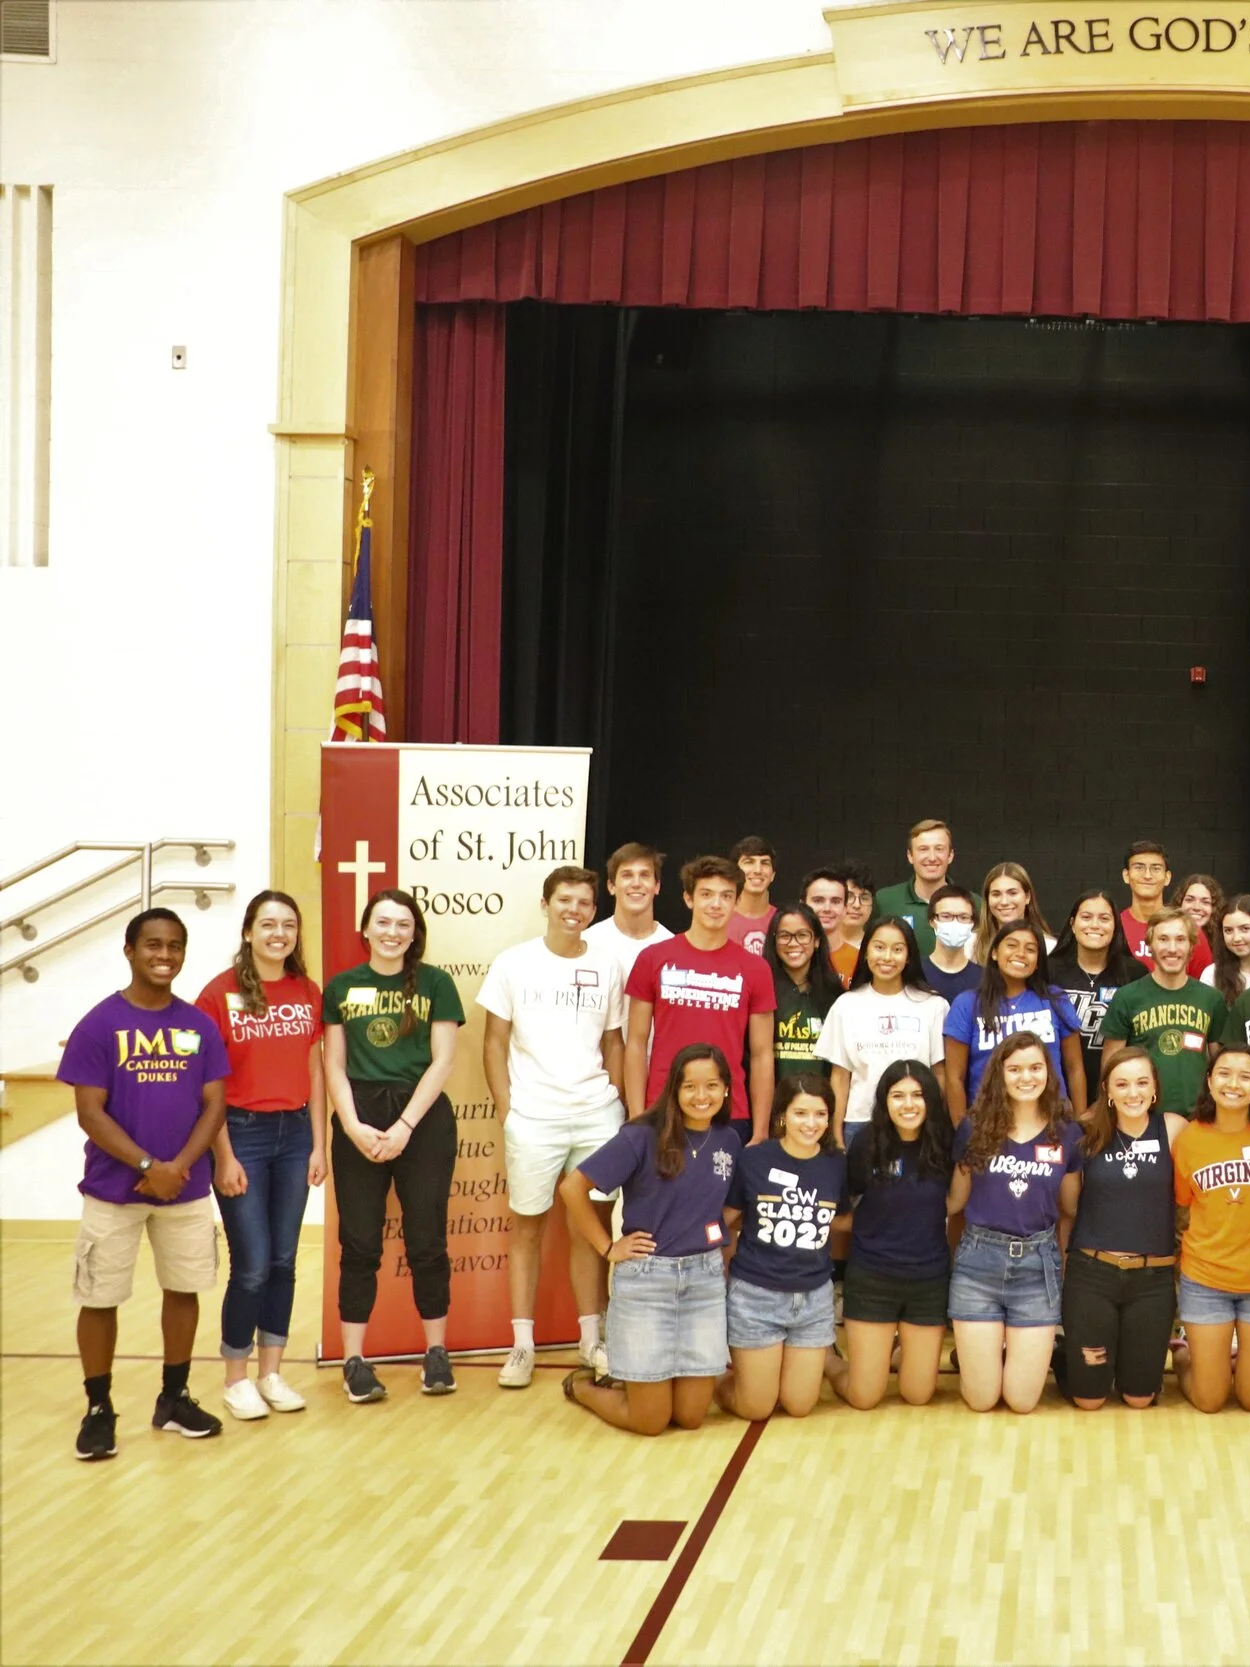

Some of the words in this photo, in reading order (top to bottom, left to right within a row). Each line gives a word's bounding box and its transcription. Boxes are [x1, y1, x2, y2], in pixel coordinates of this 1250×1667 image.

[924, 24, 1006, 65] WE
[1020, 18, 1114, 57] ARE
[410, 775, 574, 808] Associates
[409, 829, 444, 861] of
[457, 830, 494, 861] St.
[502, 829, 578, 870] John
[410, 885, 504, 915] Bosco
[669, 998, 729, 1012] COLLEGE
[232, 1021, 313, 1042] UNIVERSIT
[1132, 1004, 1211, 1036] FRANCISCAN
[126, 1060, 188, 1071] CATHOLIC
[137, 1072, 178, 1083] DUKES
[1104, 1151, 1157, 1164] UCONN
[757, 1202, 814, 1221] CLASS
[757, 1218, 830, 1250] 2023
